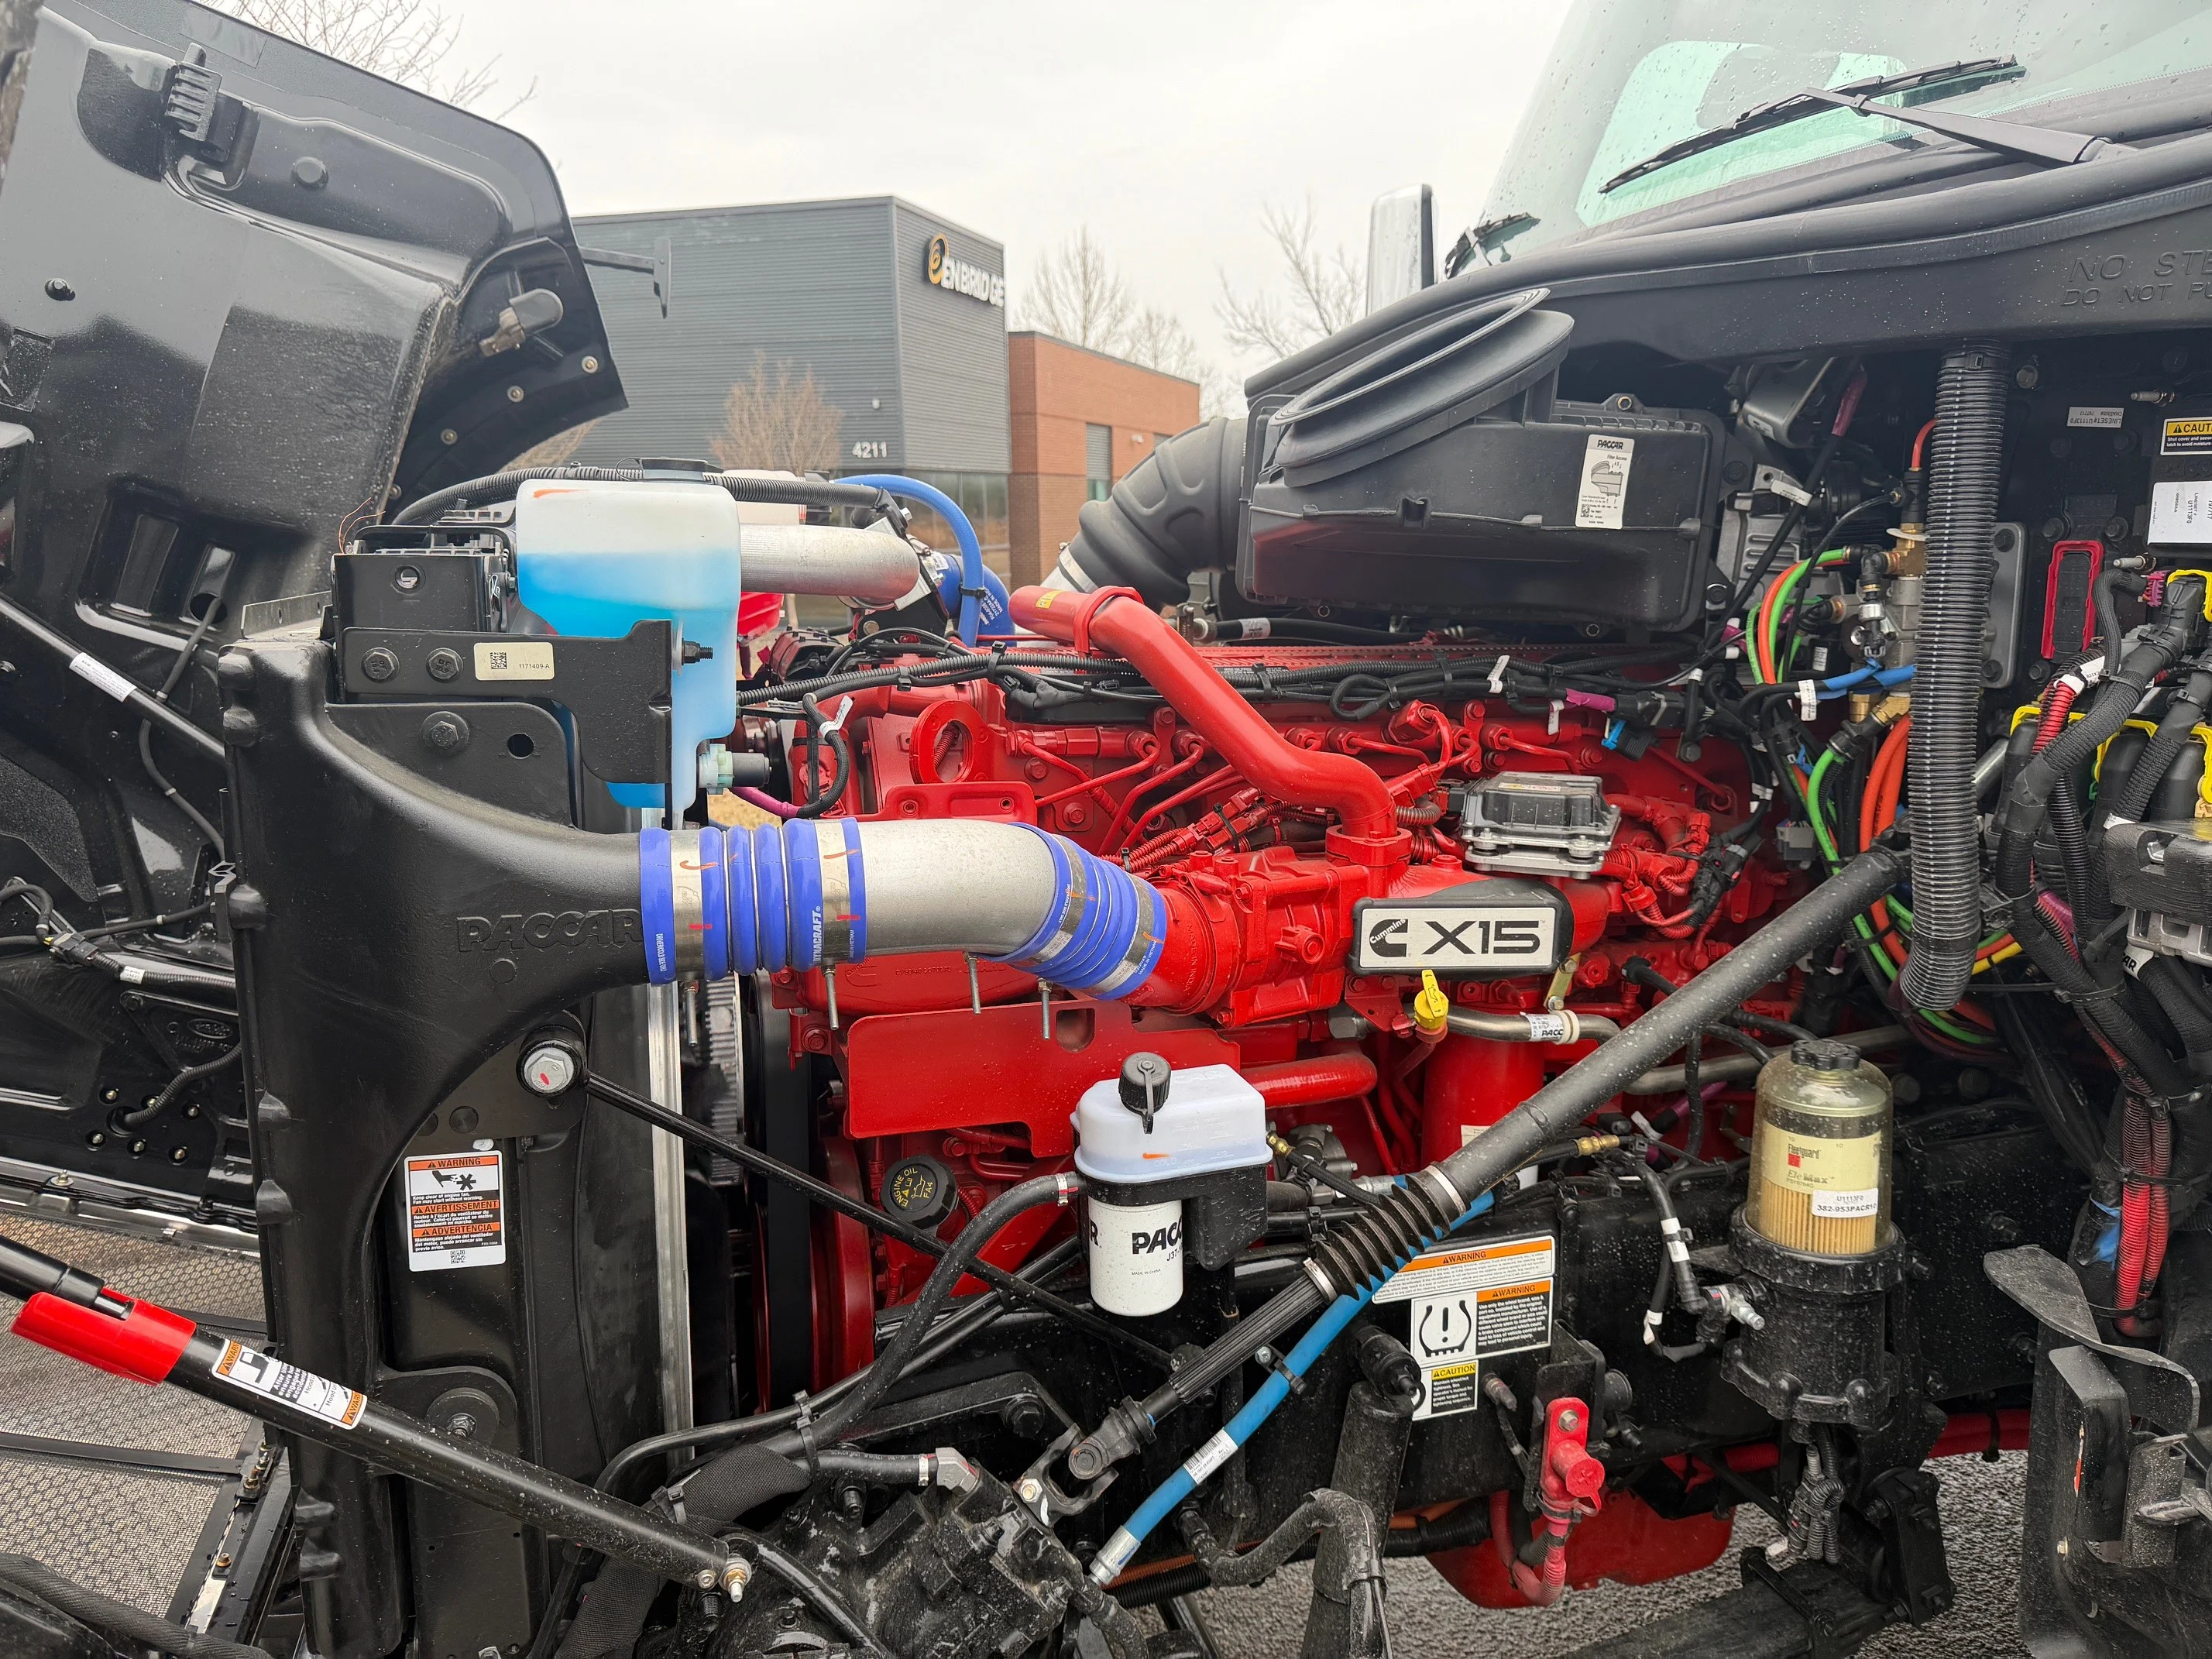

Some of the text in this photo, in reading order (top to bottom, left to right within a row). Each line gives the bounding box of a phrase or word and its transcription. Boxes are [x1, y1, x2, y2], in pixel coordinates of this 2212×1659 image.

[2069, 255, 2126, 282] NO
[2060, 288, 2100, 306] DO
[2118, 283, 2173, 303] NOT
[2184, 424, 2212, 432] CAUT
[852, 441, 888, 459] 4211
[1597, 440, 1623, 449] PACCAR
[457, 908, 644, 953] PACCAR
[1369, 919, 1406, 944] Cummins
[1422, 921, 1540, 954] X15
[1788, 1144, 1819, 1159] Fleetguard
[438, 1158, 481, 1167] WARNING
[894, 1167, 918, 1207] ENGINE OIL
[923, 1181, 933, 1198] FA4
[424, 1200, 497, 1213] AVERTISSEMENT
[431, 1224, 493, 1235] ADVERTENCIA
[1448, 1252, 1486, 1263] WARNING
[1499, 1285, 1536, 1297] WARNING
[1441, 1365, 1475, 1376] CAUTION
[273, 1374, 285, 1390] After
[279, 1374, 293, 1396] ensure
[285, 1372, 300, 1398] engaged
[325, 1391, 336, 1406] Hood
